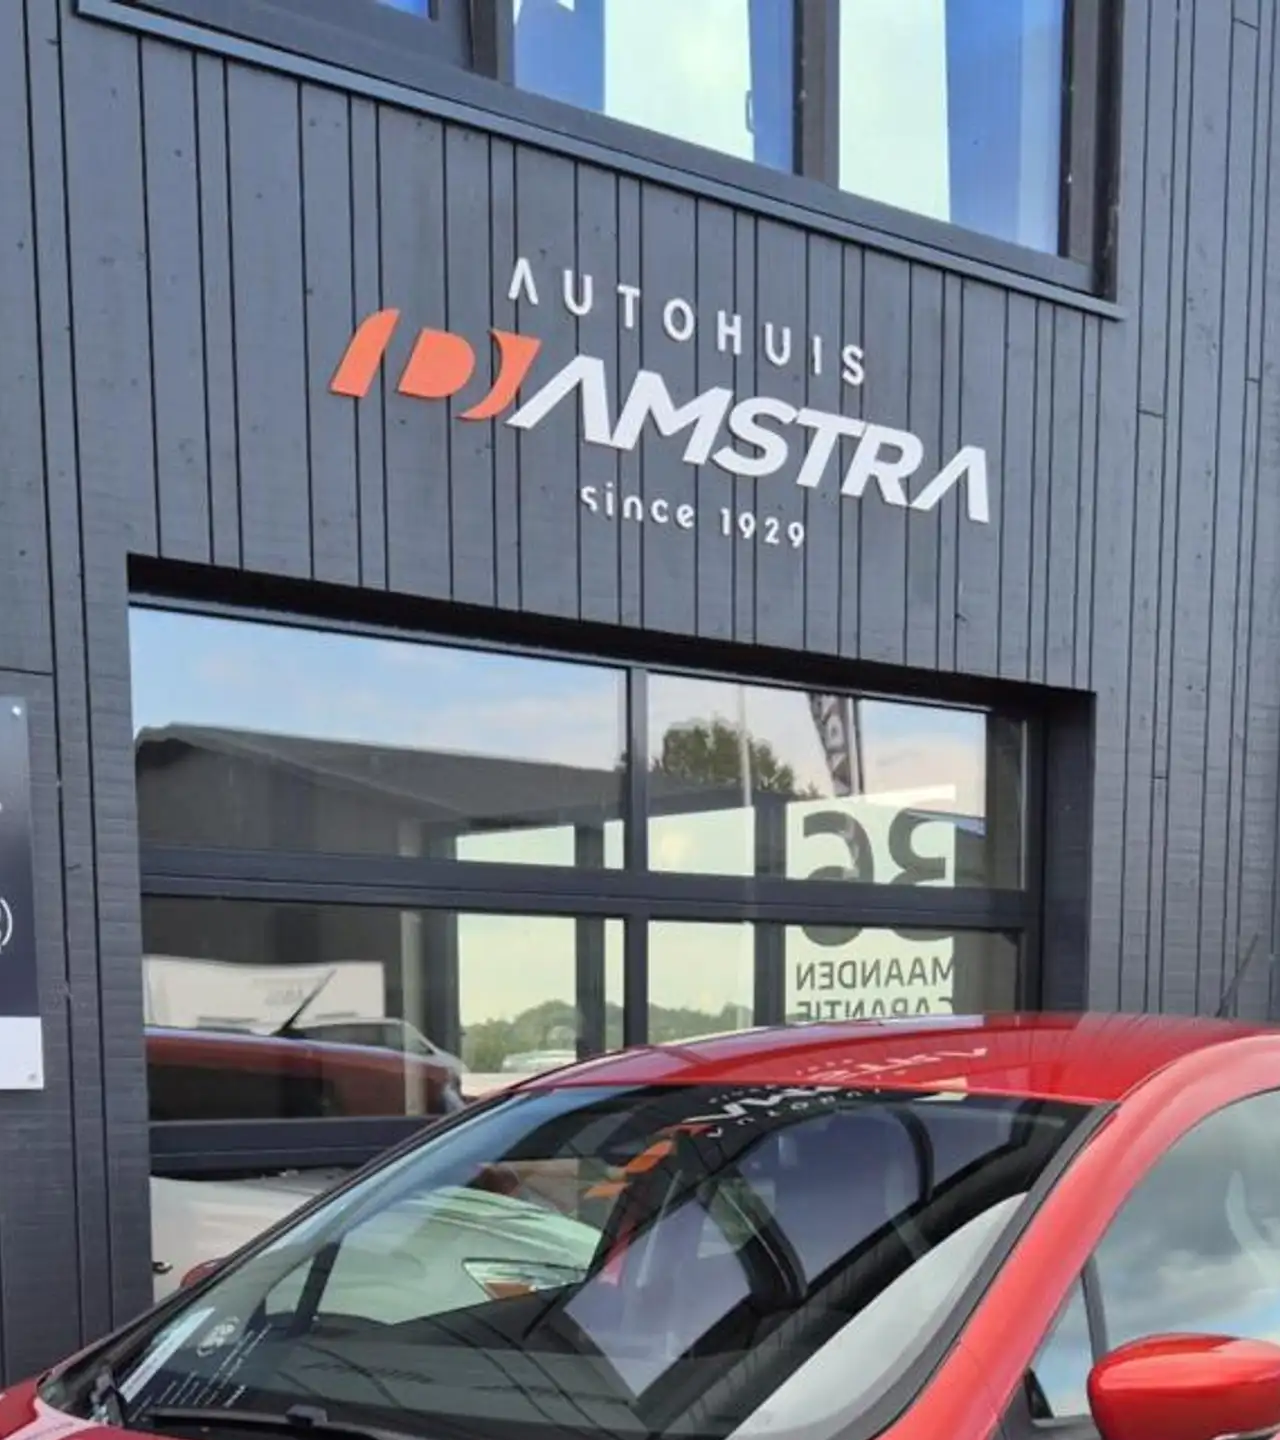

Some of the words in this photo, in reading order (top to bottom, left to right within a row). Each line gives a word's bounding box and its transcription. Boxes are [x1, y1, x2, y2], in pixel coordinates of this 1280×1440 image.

[508, 257, 866, 387] AUTOHUIS
[397, 324, 990, 523] DAMSTRA
[579, 482, 695, 530] since
[720, 508, 806, 548] 1929
